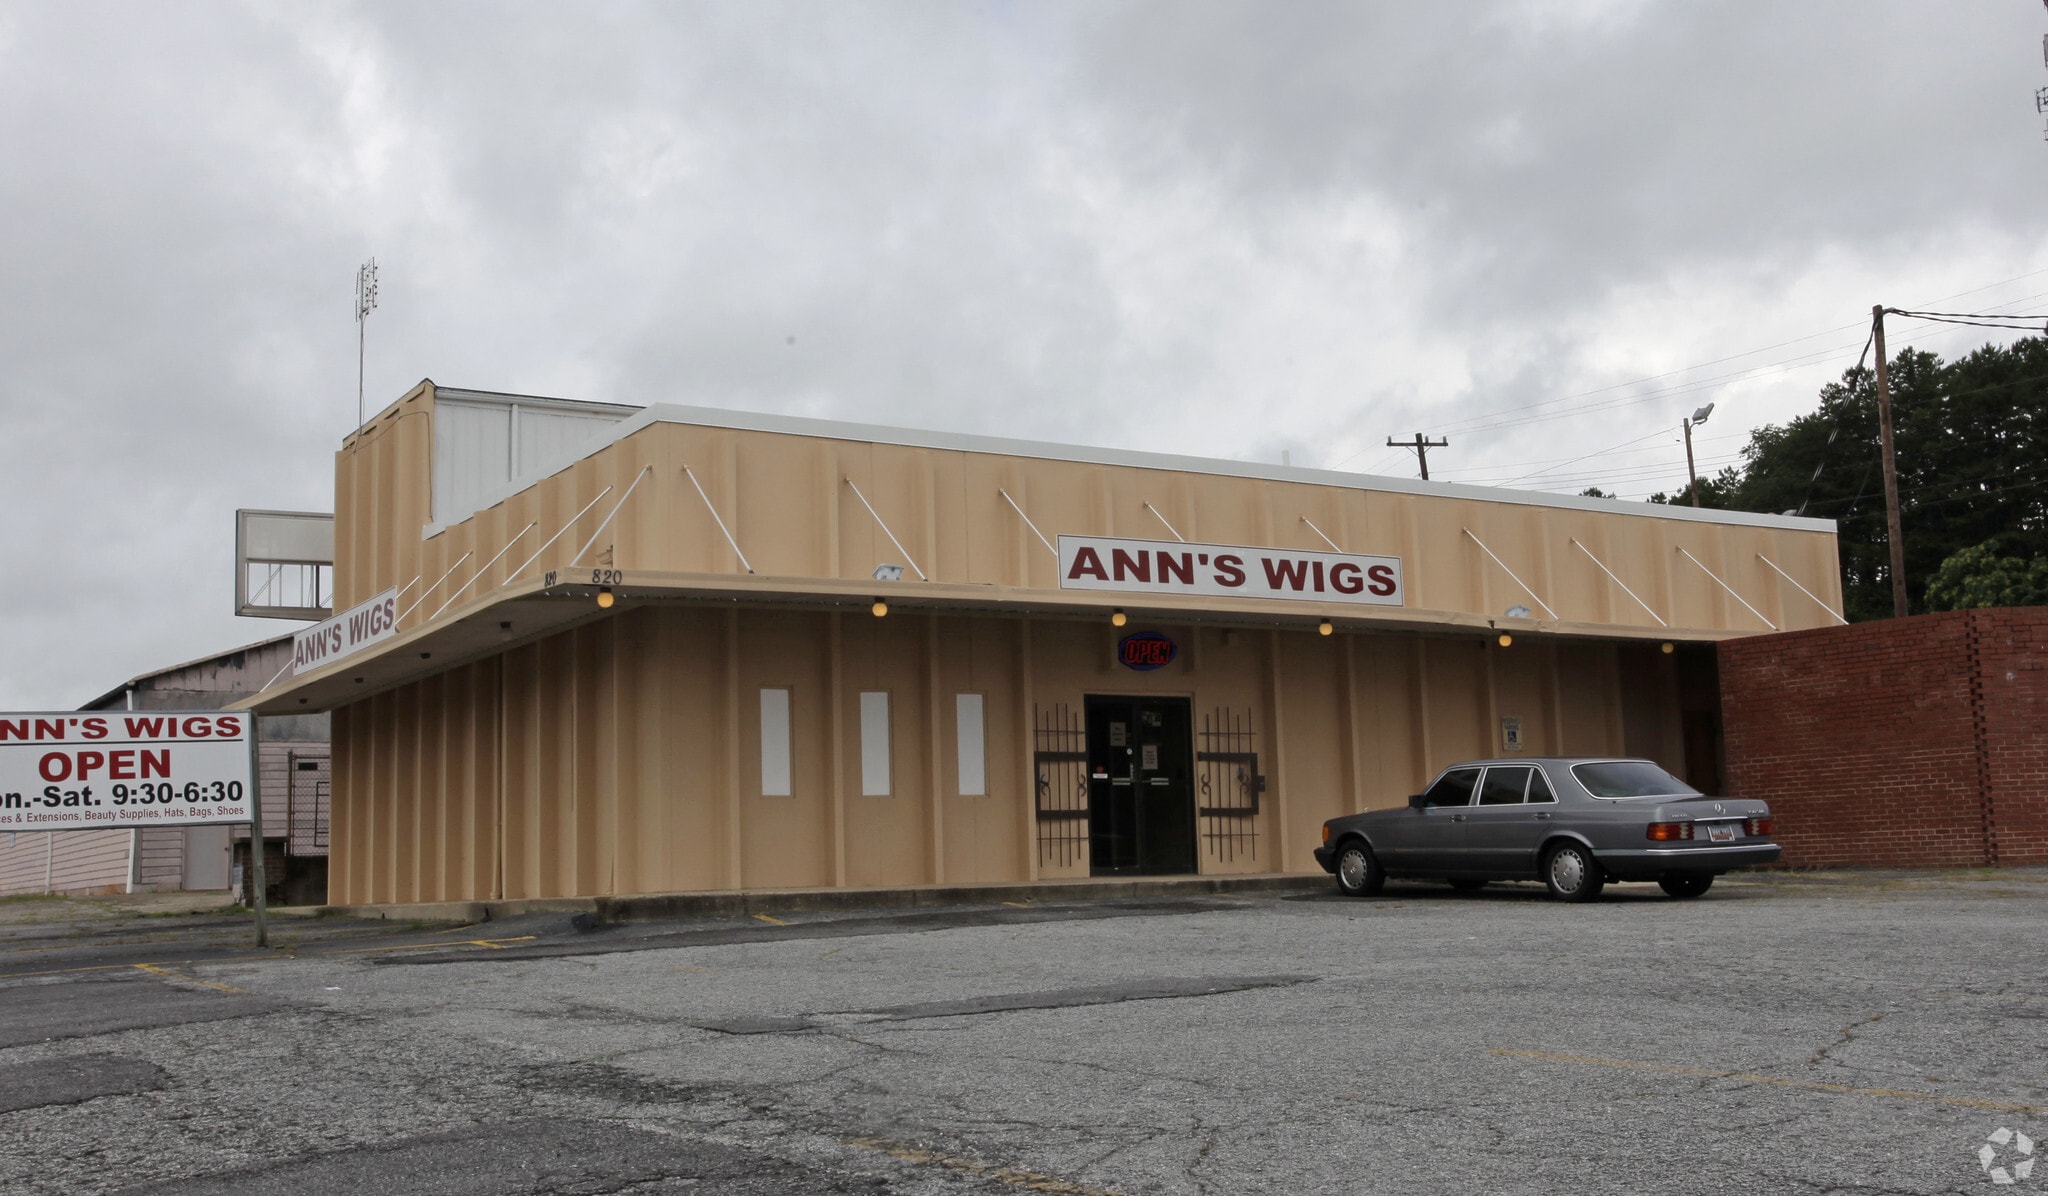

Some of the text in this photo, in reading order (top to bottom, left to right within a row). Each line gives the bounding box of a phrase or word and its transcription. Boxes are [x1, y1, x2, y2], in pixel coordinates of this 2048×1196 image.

[544, 570, 557, 587] 820
[592, 568, 623, 585] 820
[1067, 546, 1397, 597] ANN'S WIGS
[295, 598, 394, 669] ANN'S WIGS
[1124, 640, 1170, 665] OPEN
[124, 716, 242, 738] WIGS
[38, 749, 171, 783] OPEN
[0, 780, 244, 809] n.-Sat. 9:30-6:30
[0, 805, 245, 824] es & Extensions, Beauty Supplies, Hats, Bags, Shoes
